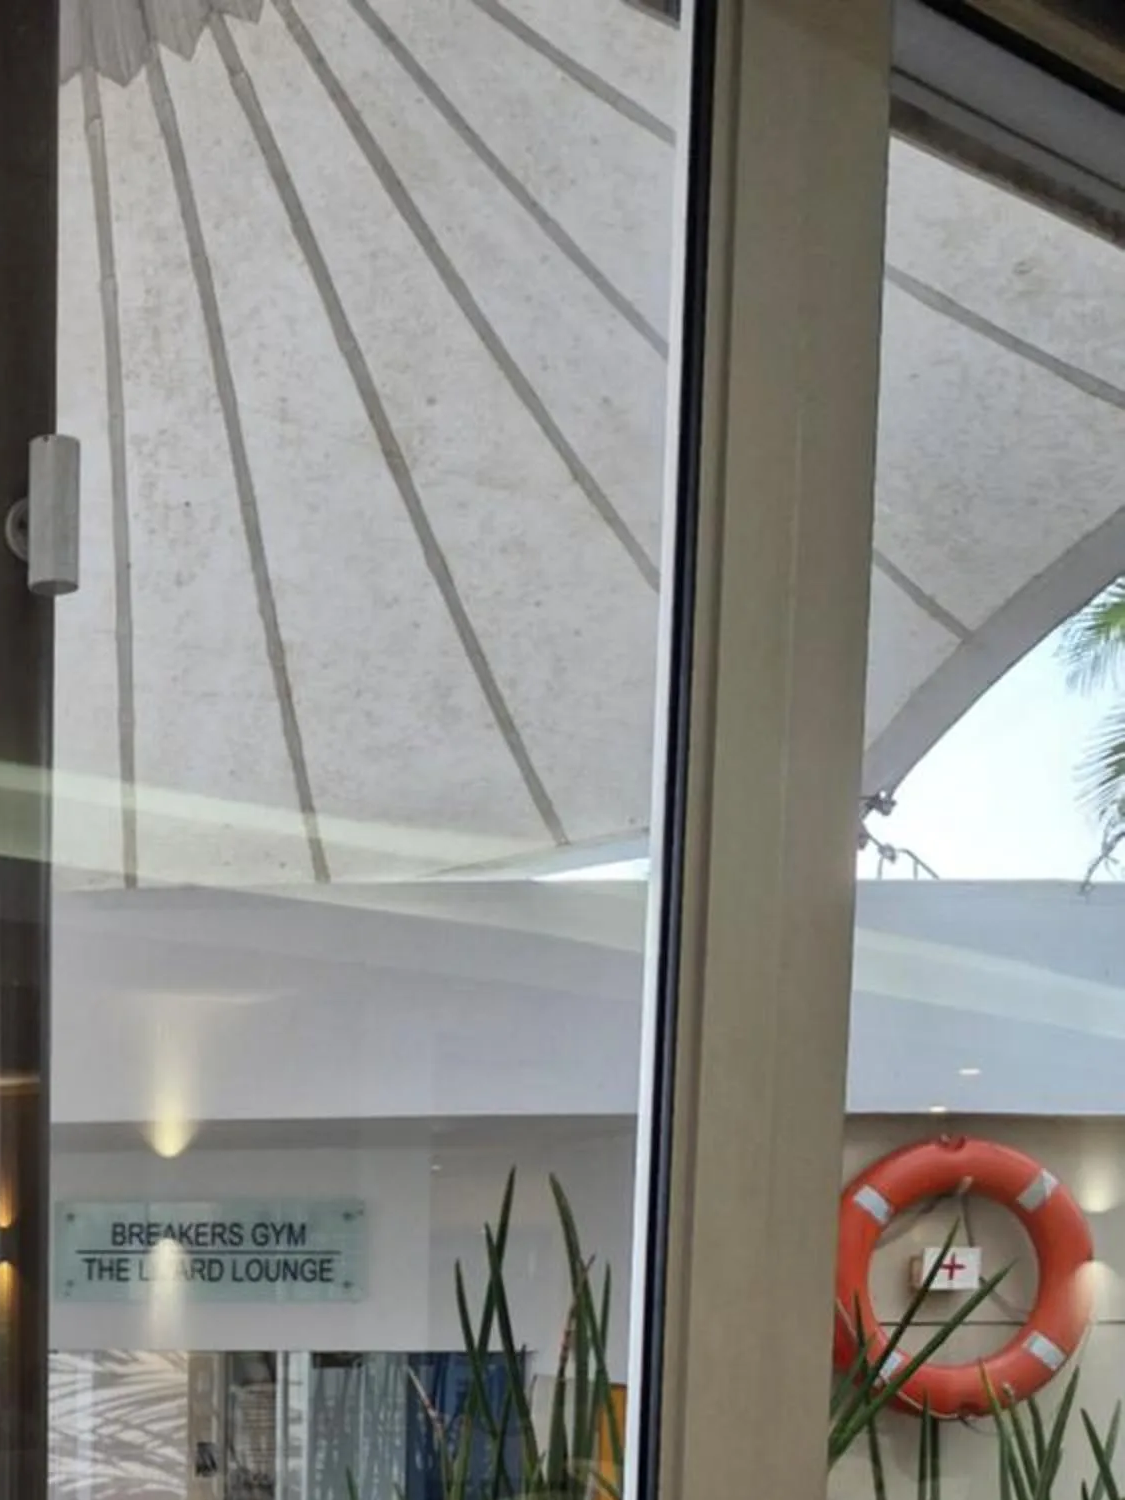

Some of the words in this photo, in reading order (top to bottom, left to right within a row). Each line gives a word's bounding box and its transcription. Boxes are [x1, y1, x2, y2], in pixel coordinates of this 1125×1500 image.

[111, 1222, 244, 1247] BREAKERS
[251, 1222, 307, 1247] GYM
[83, 1258, 131, 1282] THE
[232, 1258, 335, 1283] LOUNGE
